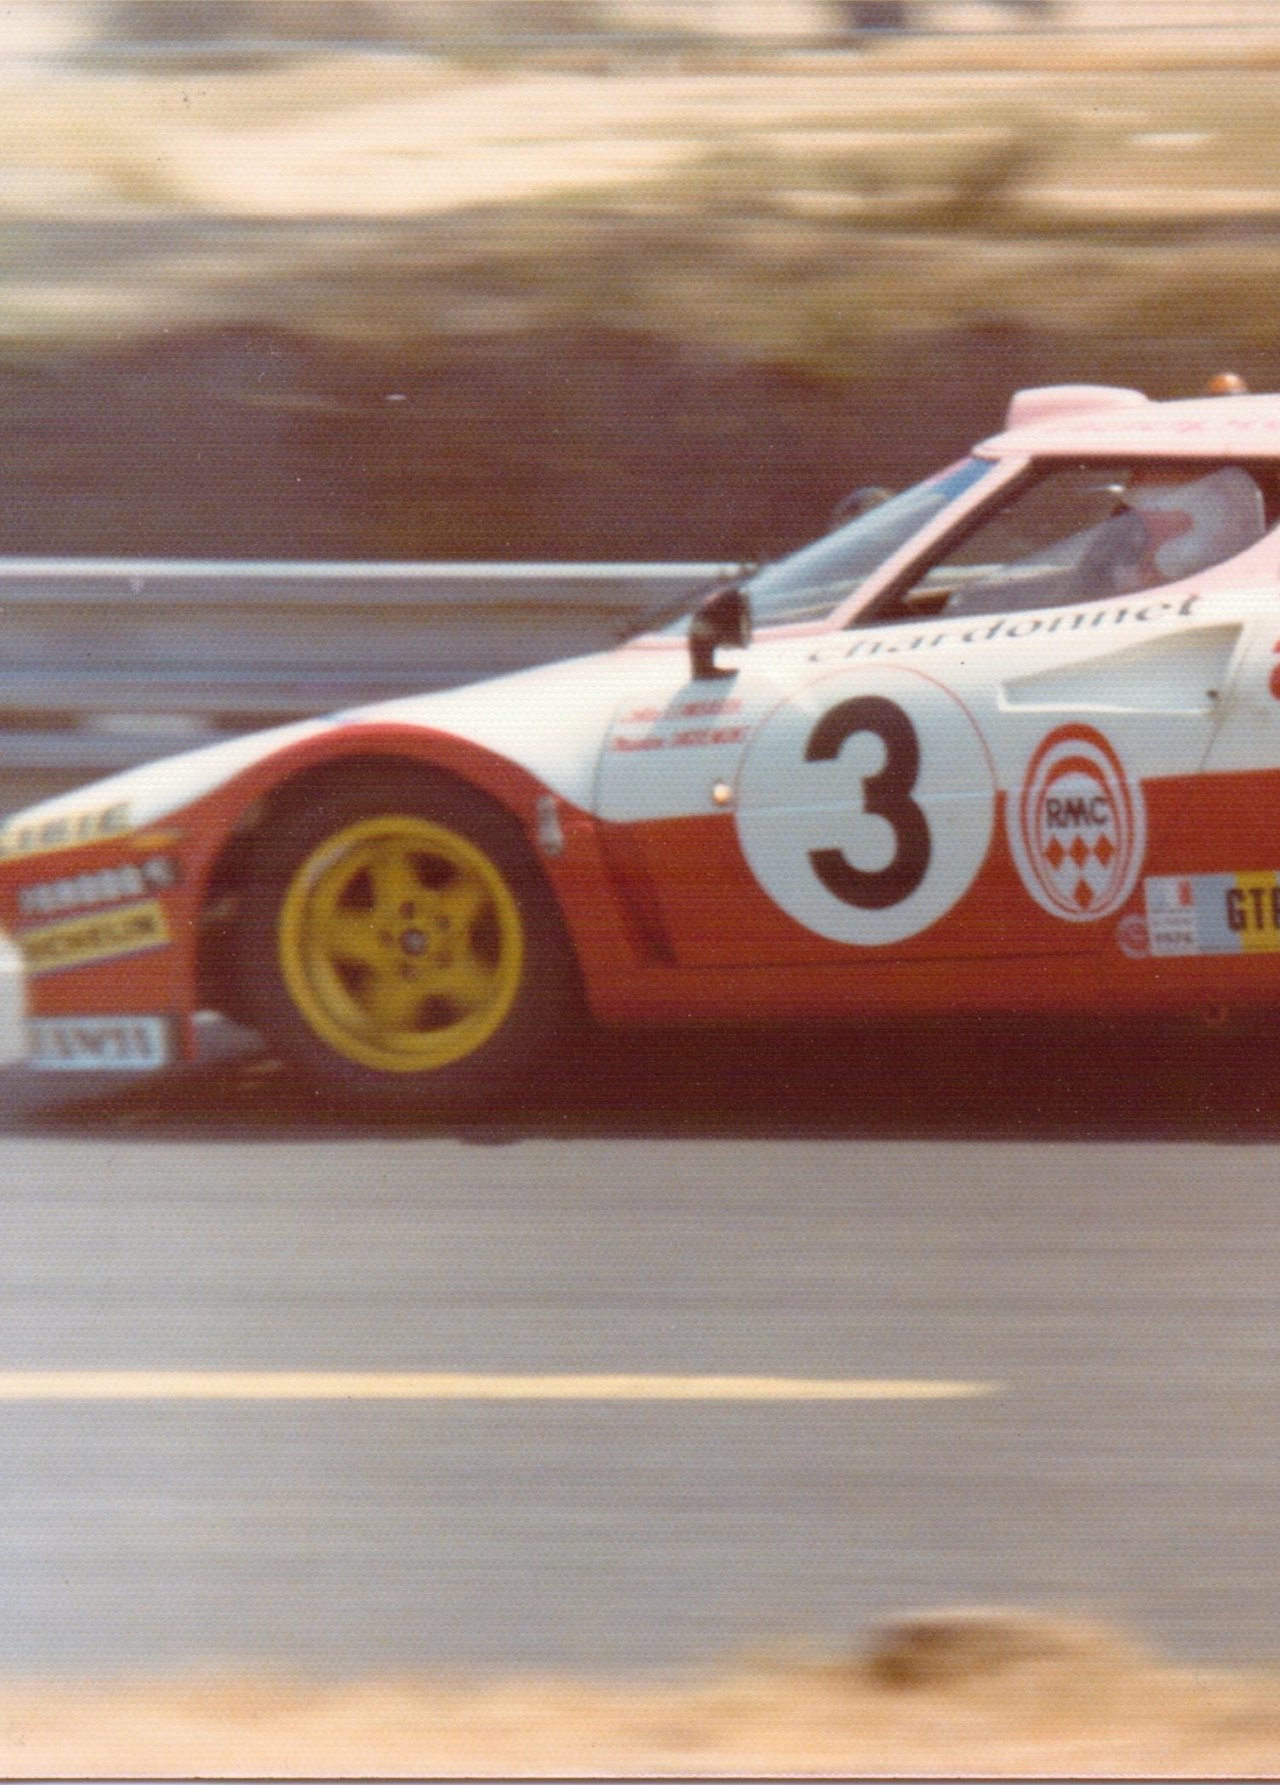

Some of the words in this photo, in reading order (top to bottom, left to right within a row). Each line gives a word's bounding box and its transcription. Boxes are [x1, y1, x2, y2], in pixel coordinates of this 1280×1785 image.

[808, 594, 1203, 662] chardonnet
[804, 694, 932, 911] 3
[1045, 796, 1110, 828] RMC
